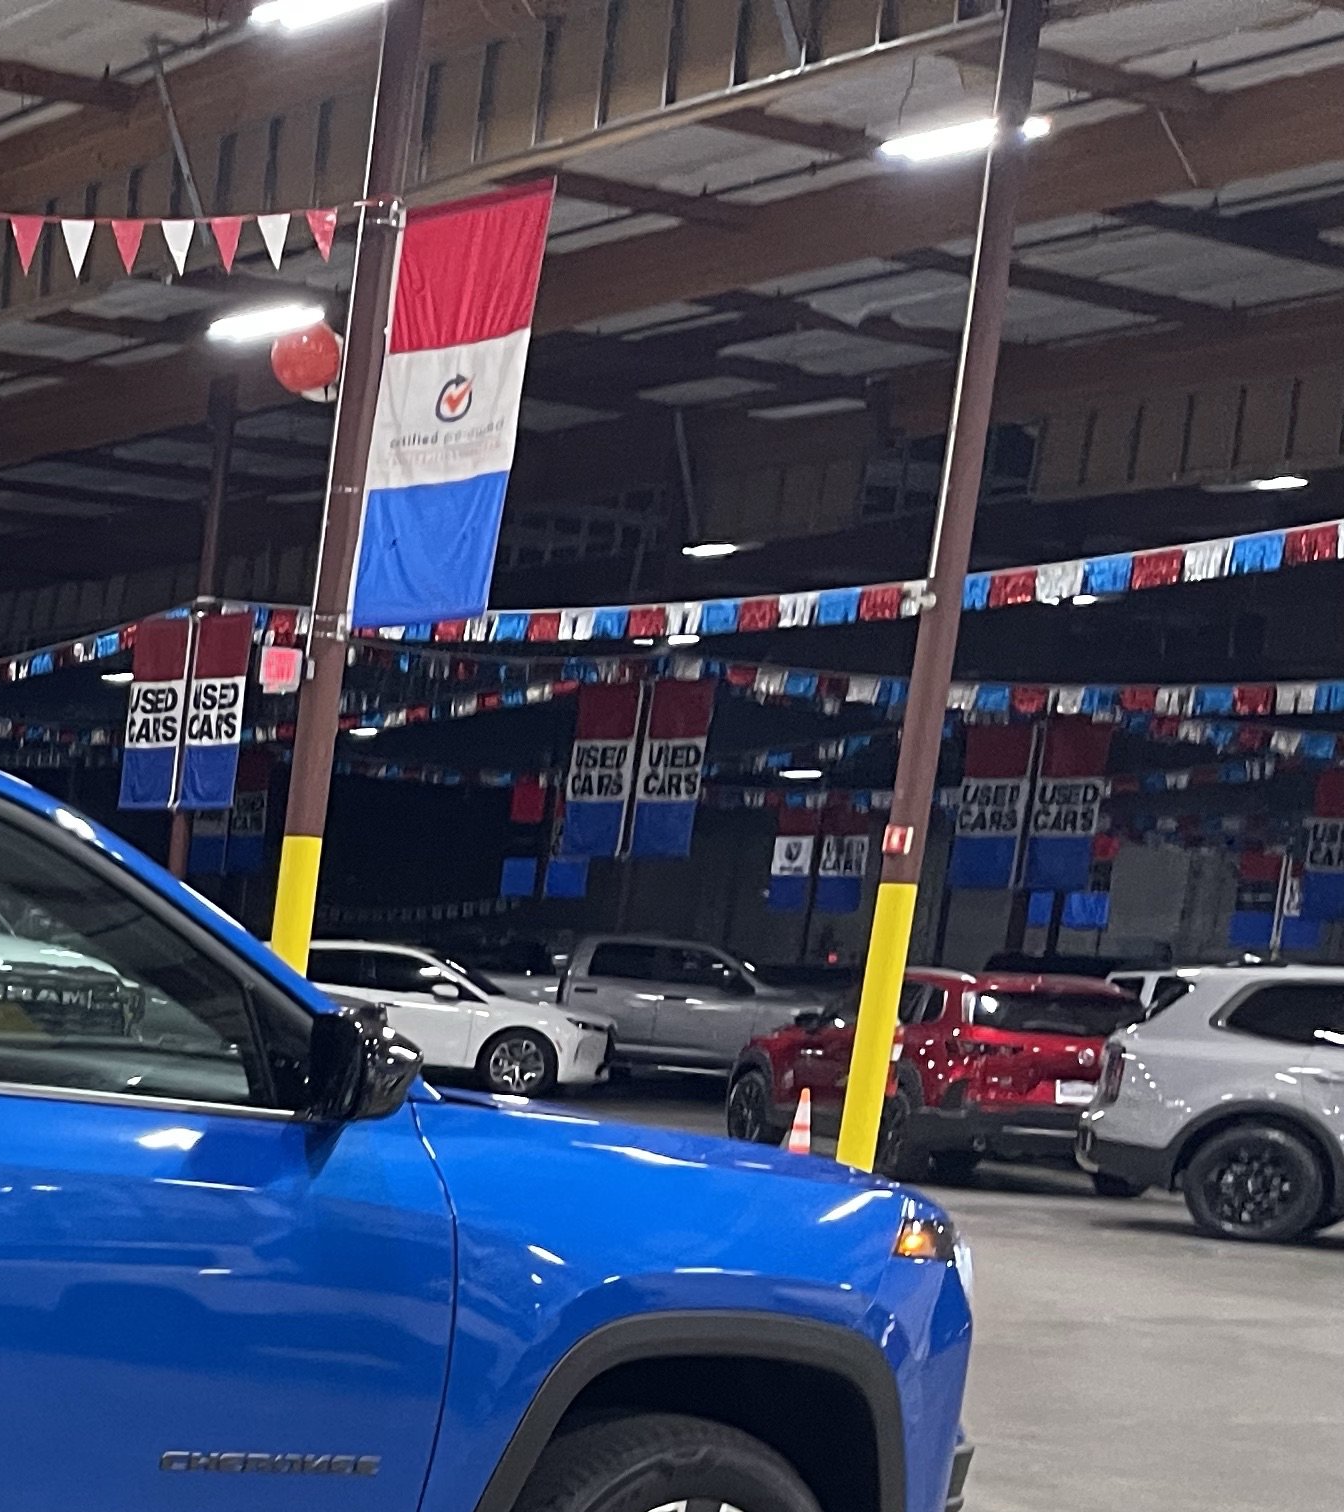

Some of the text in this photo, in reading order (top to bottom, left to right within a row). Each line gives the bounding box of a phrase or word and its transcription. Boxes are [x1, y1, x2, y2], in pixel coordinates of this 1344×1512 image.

[193, 683, 239, 710] USED
[128, 715, 177, 743] CARS
[188, 712, 237, 740] CARS
[576, 744, 628, 769] USED
[571, 772, 623, 796] CARS
[643, 772, 699, 796] CARS
[160, 1450, 382, 1477] CHEROKEE
